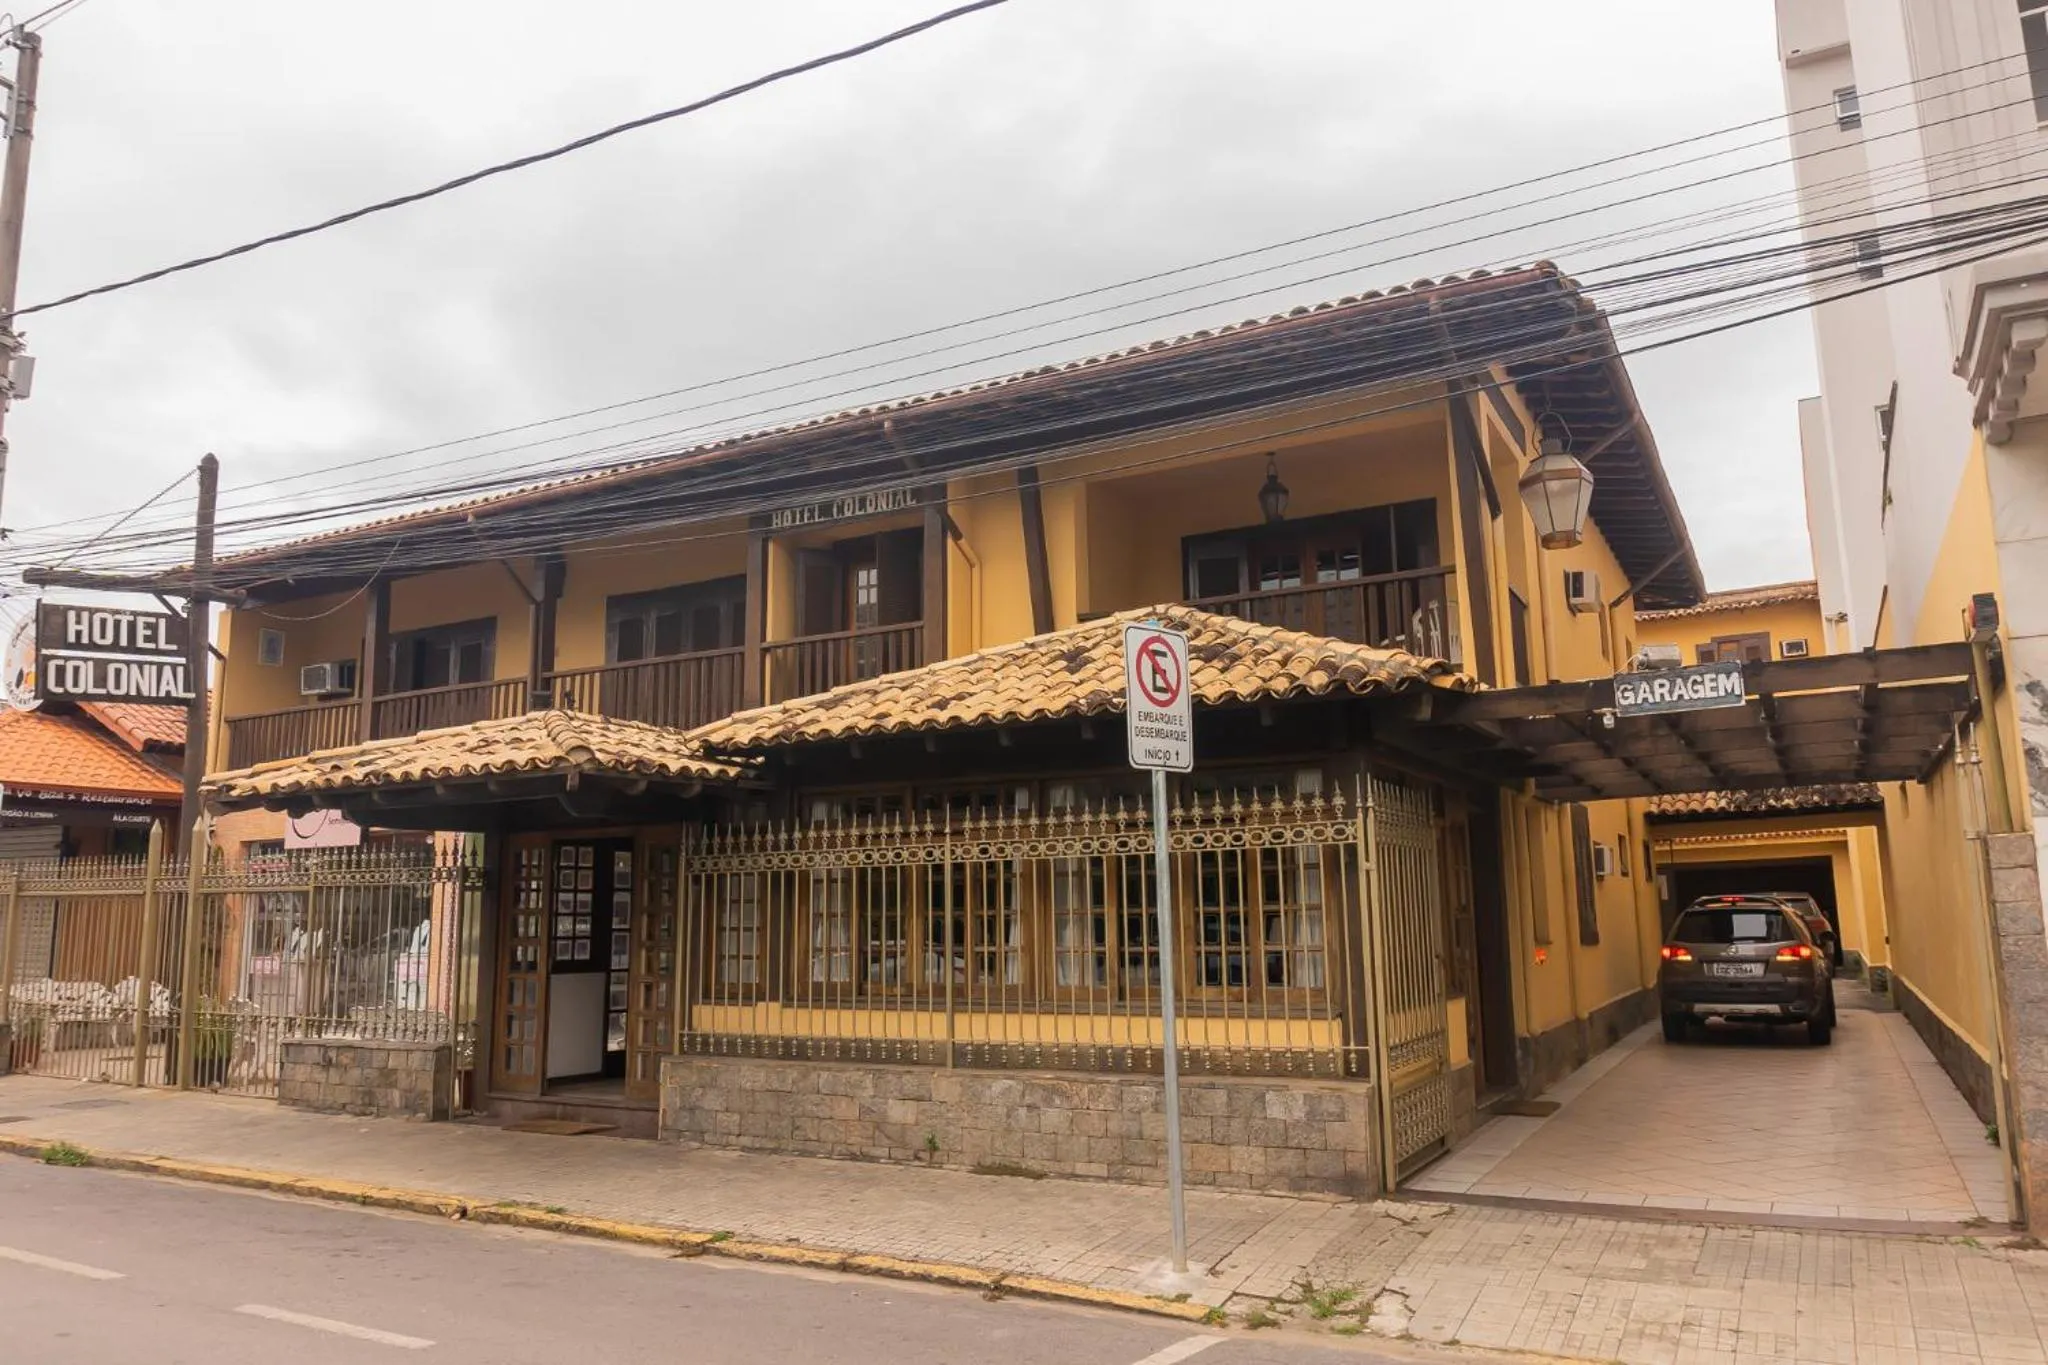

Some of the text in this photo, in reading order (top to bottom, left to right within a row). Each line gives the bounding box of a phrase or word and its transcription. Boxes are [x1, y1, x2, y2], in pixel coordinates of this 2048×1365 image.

[772, 487, 917, 528] HOTEL COLONIAL
[66, 609, 178, 651] HOTEL
[46, 658, 196, 699] COLONIAL
[1617, 671, 1742, 706] GARAGEM
[1135, 725, 1188, 742] DESEMBARQUE
[1138, 711, 1178, 726] EMBARQUE
